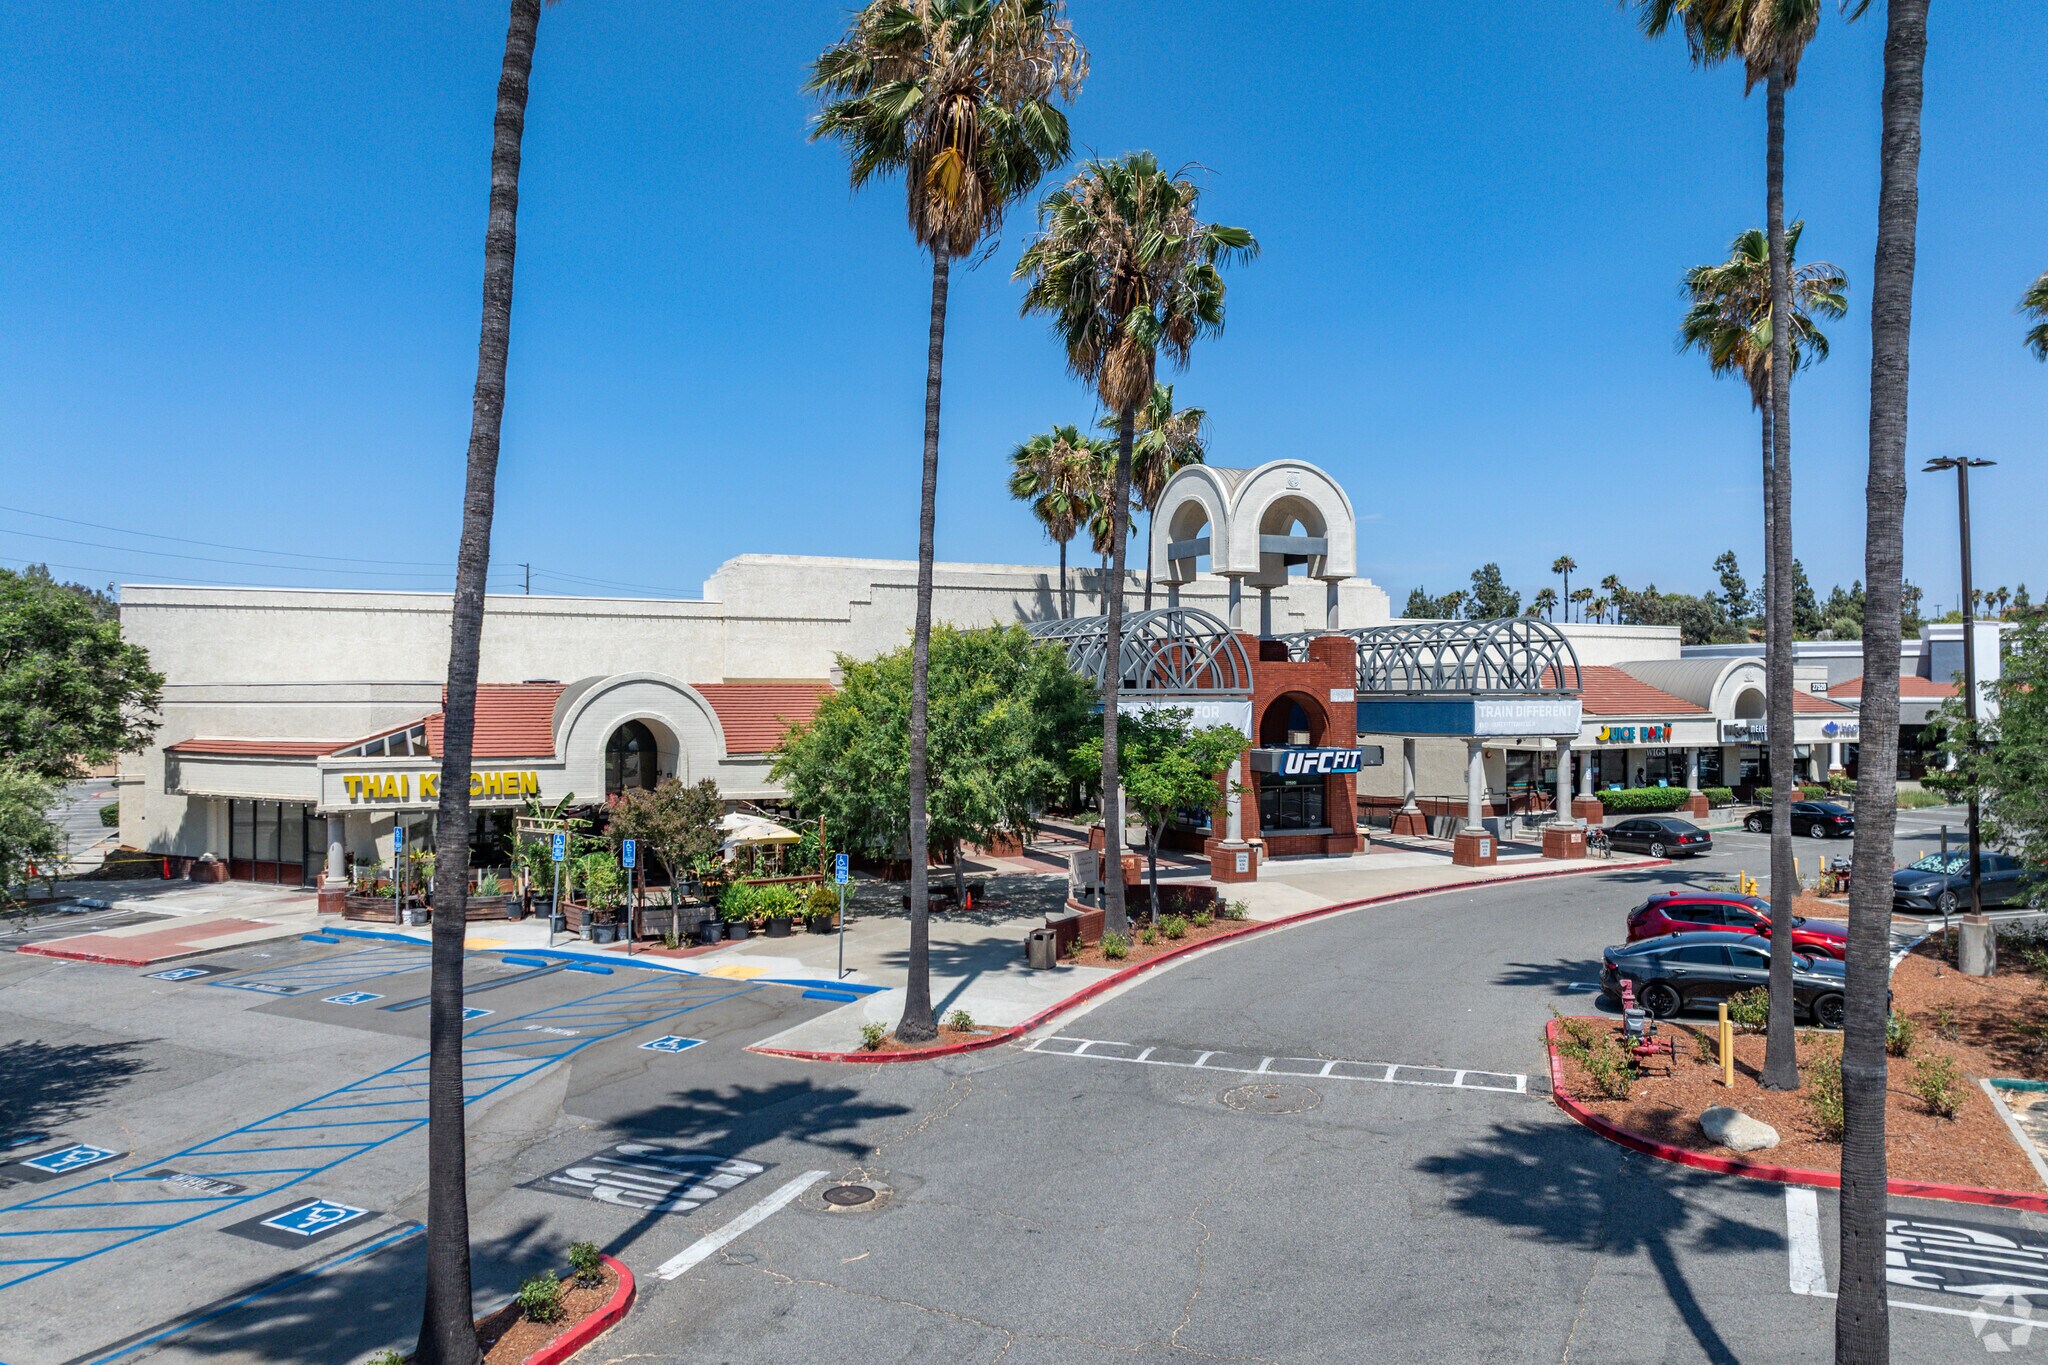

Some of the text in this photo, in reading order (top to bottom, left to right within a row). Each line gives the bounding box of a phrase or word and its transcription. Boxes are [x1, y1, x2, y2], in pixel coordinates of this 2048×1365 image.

[1194, 706, 1220, 718] FOR
[1479, 705, 1573, 718] TRAIN DIFFERENT
[1596, 726, 1635, 740] JUICE
[1647, 748, 1666, 757] WIGS
[343, 771, 537, 799] THAI KCHEN
[550, 1144, 764, 1212] STOP
